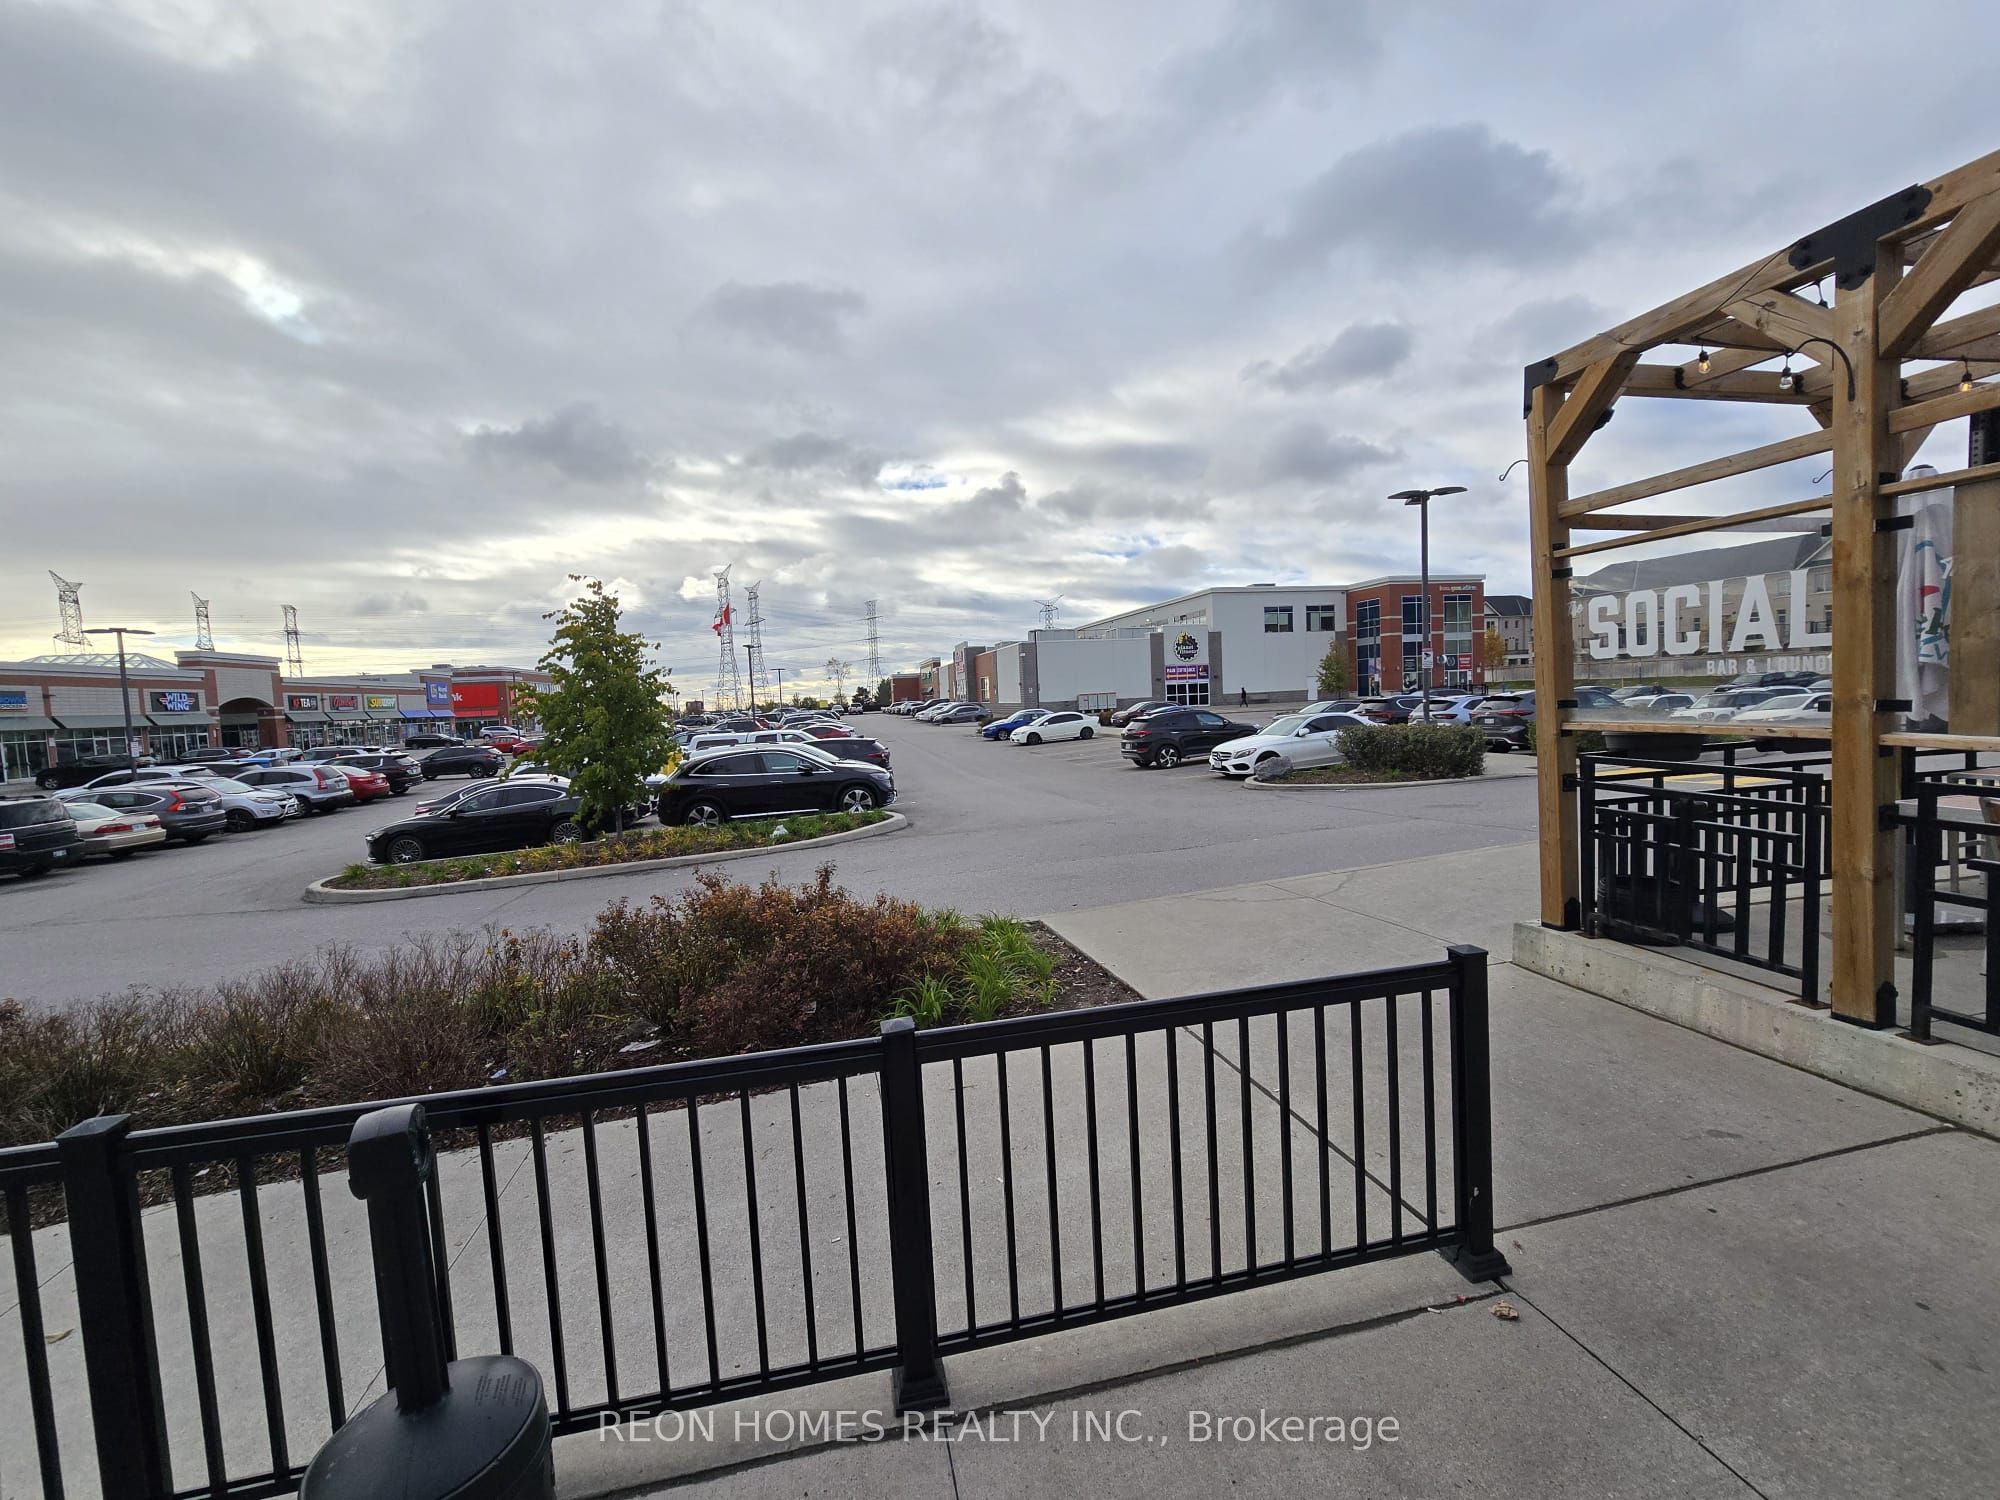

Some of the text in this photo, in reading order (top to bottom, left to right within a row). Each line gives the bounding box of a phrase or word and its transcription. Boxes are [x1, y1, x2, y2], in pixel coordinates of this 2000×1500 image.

[1588, 568, 1832, 660] SOCIAL
[1706, 654, 1831, 676] BAR & LOUNG
[165, 692, 188, 702] WILD
[166, 701, 190, 711] WING
[300, 698, 311, 708] TEA
